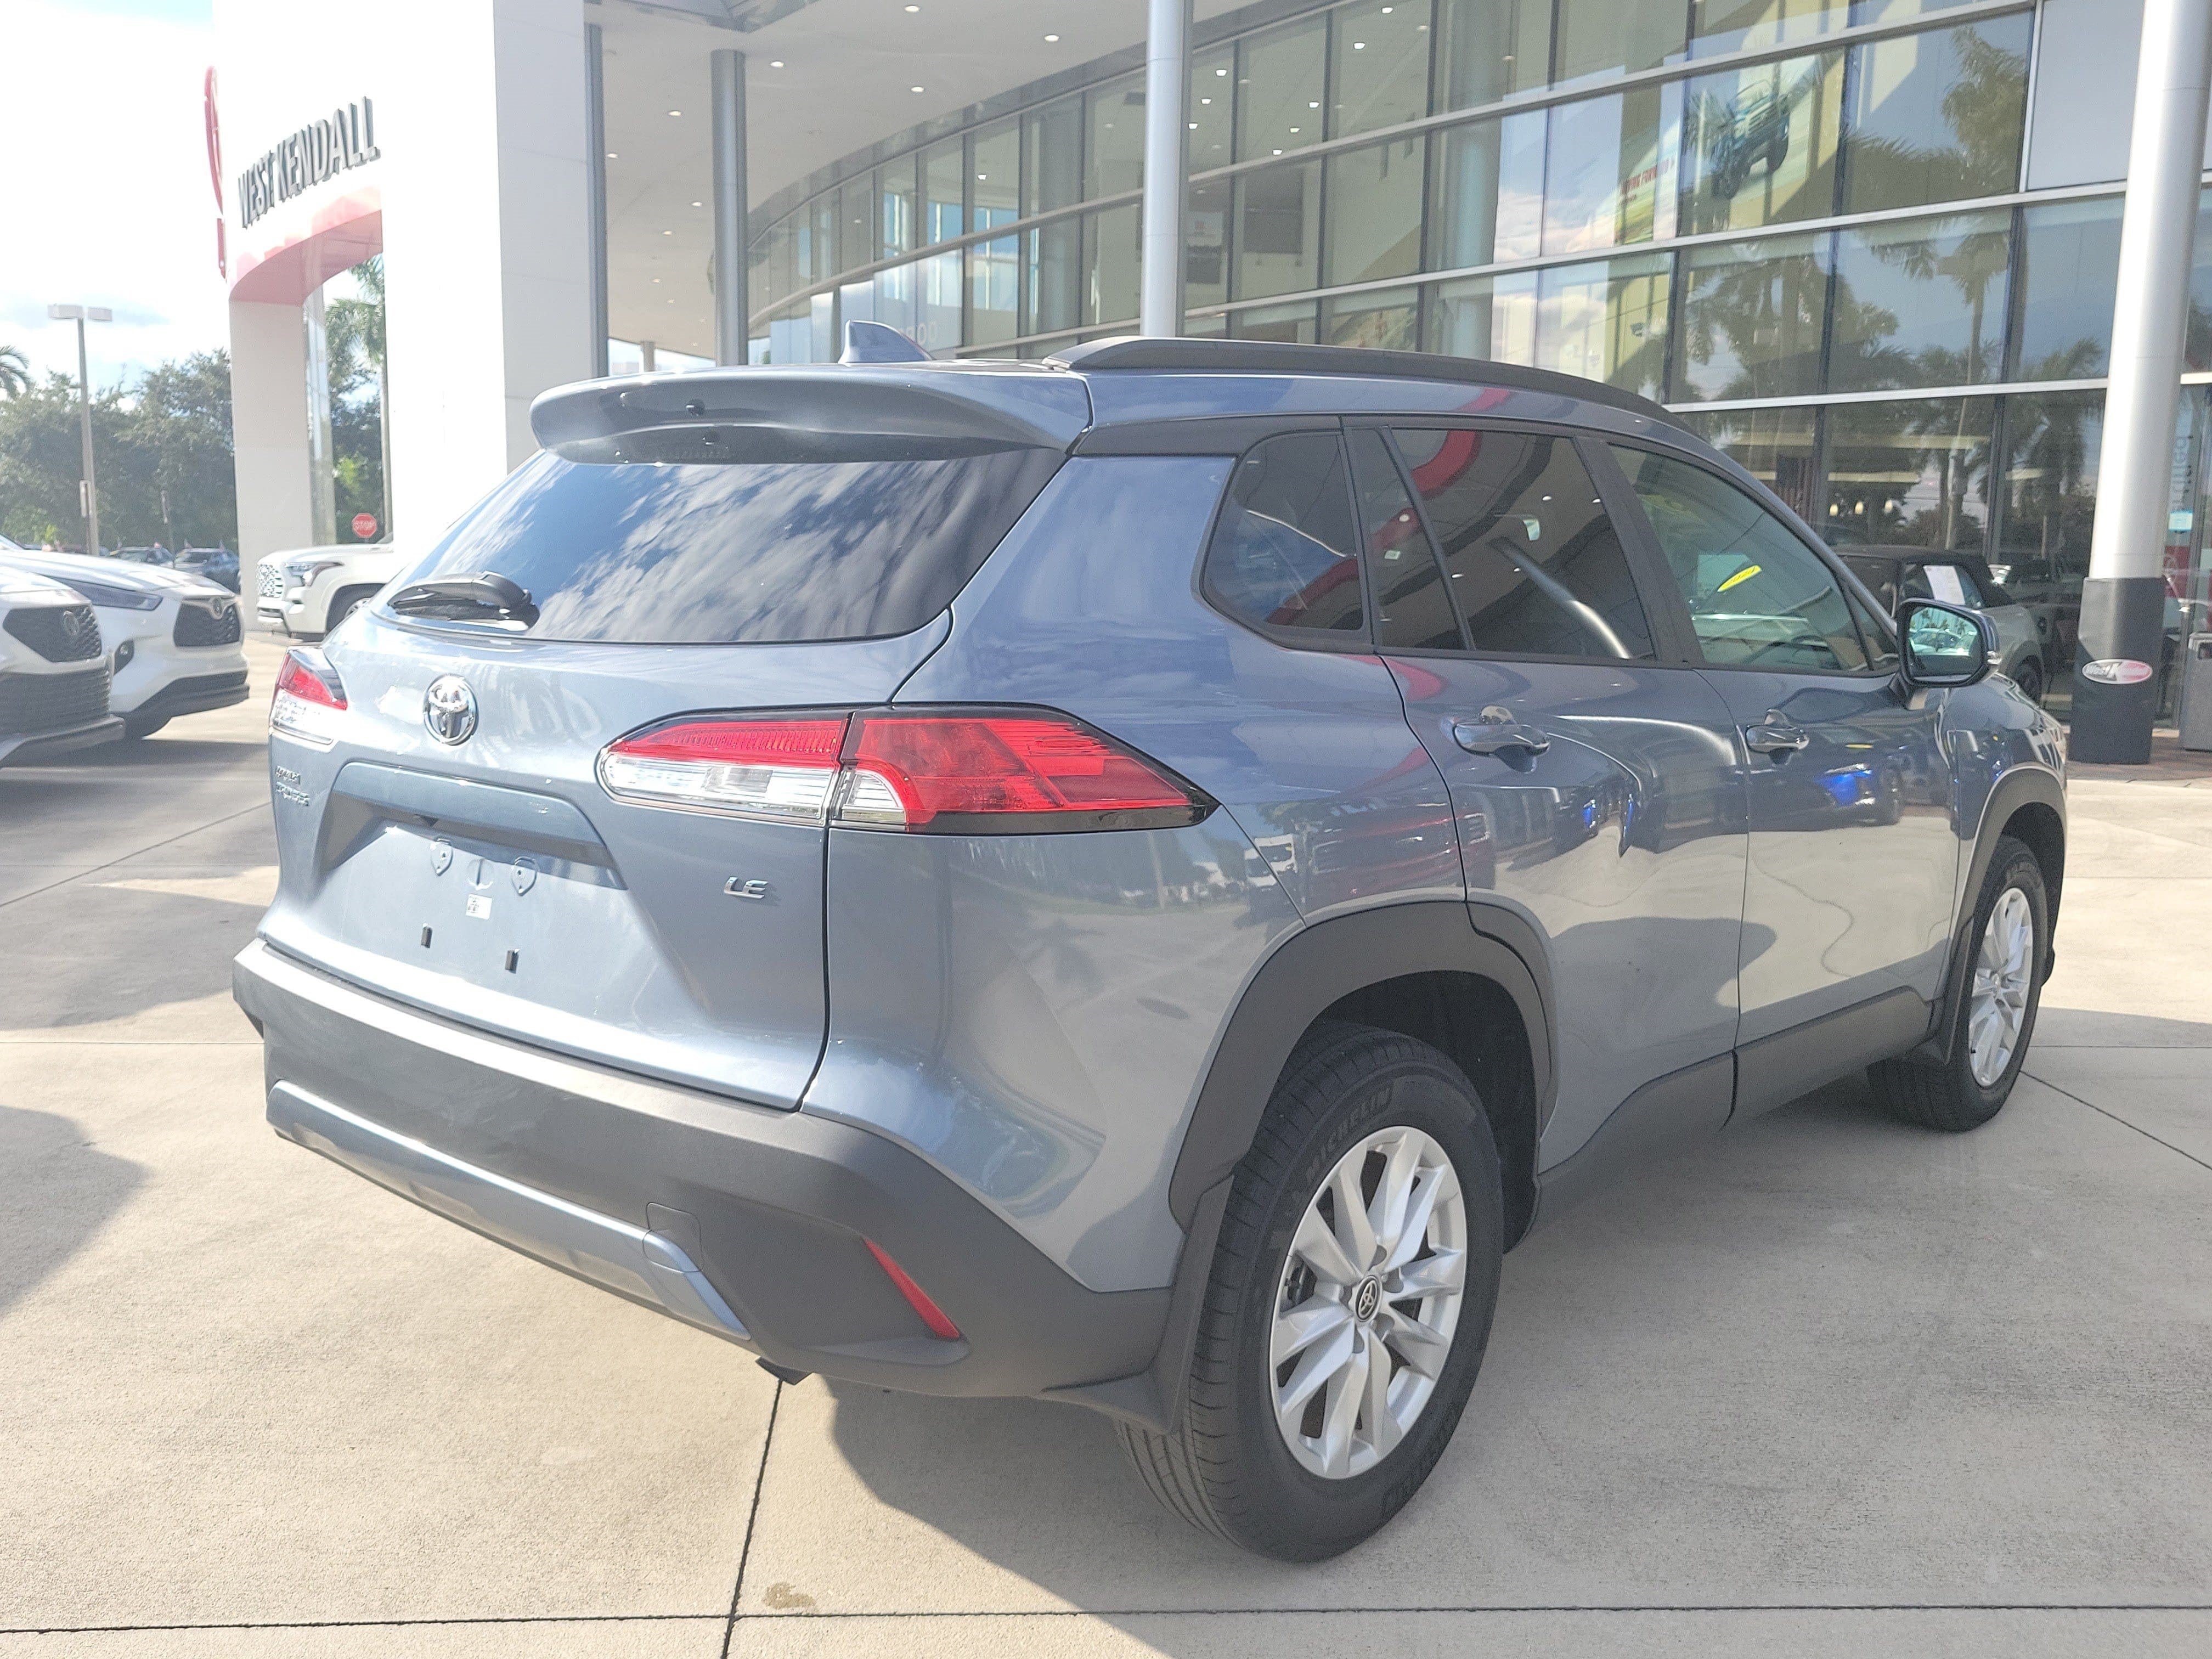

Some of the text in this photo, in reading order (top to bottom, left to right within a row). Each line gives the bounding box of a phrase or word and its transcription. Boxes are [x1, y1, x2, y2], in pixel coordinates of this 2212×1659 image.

[238, 96, 381, 229] WEST KENDALL
[724, 876, 769, 899] LE
[1306, 1087, 1391, 1186] MICHELIN
